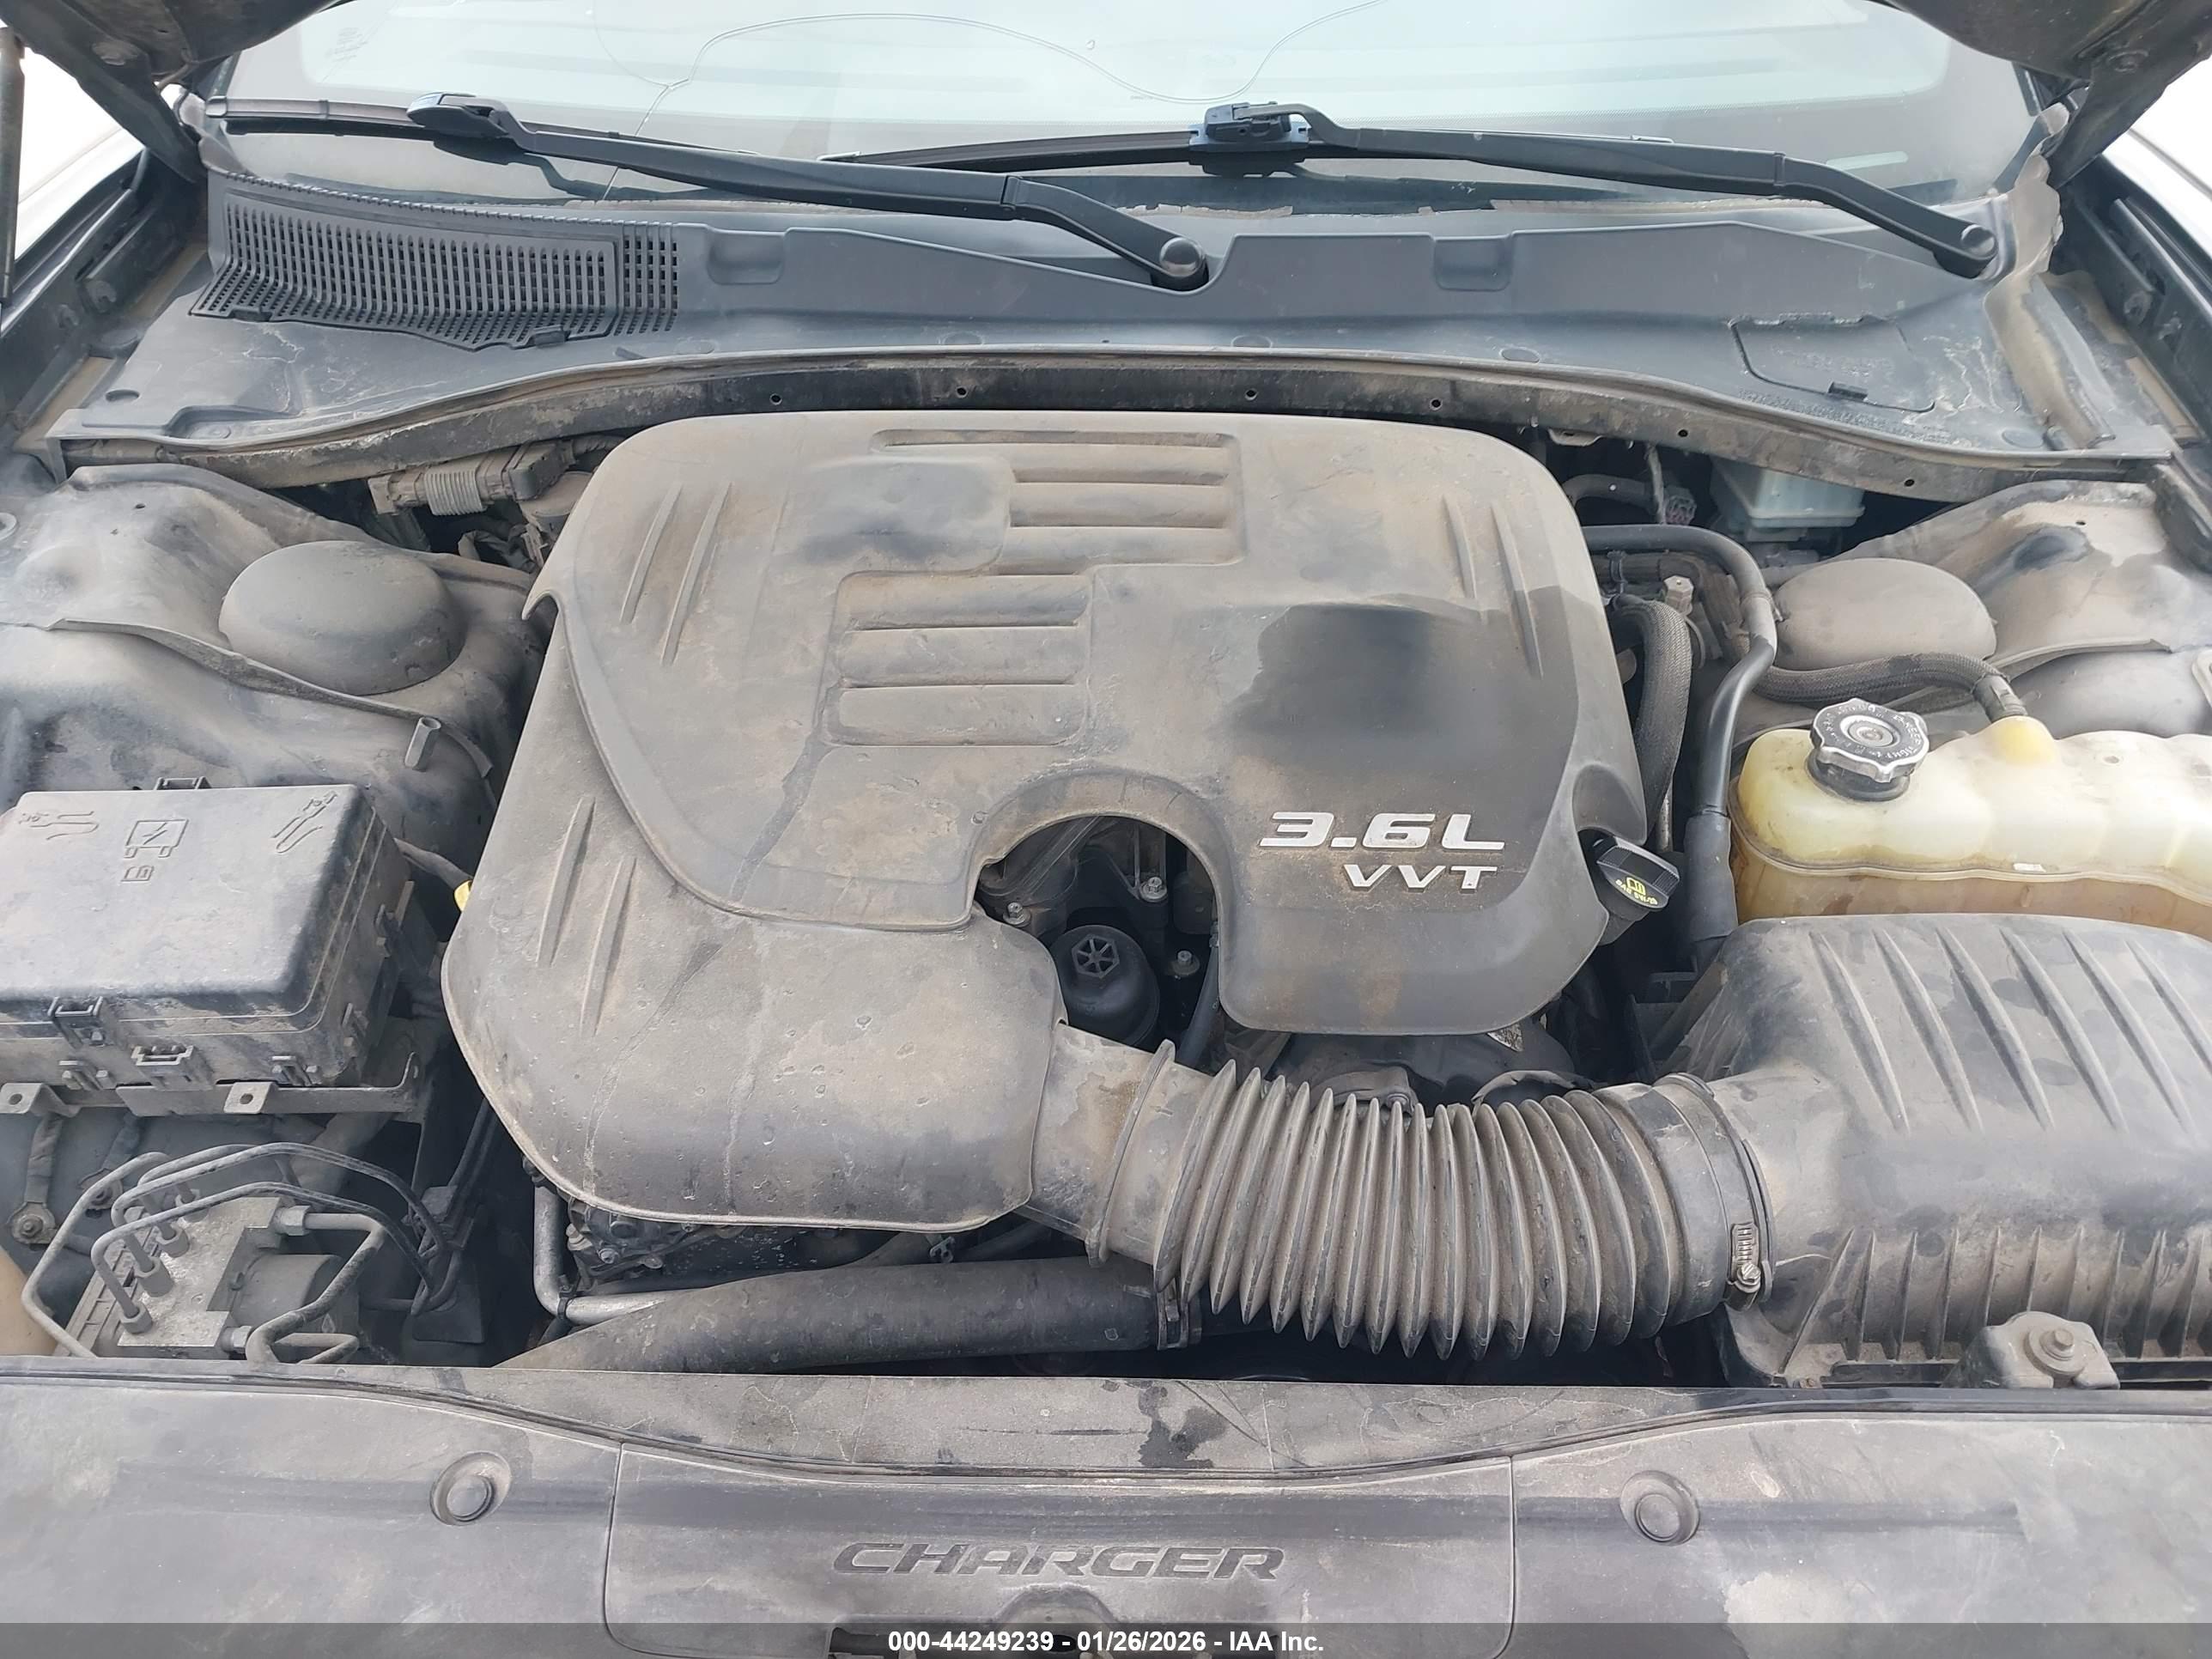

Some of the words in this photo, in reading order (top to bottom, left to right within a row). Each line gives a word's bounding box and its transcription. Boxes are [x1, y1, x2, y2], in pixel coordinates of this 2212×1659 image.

[1260, 812, 1505, 848] 3.6L
[1344, 865, 1497, 890] VVT
[833, 1543, 1285, 1579] CHARGER
